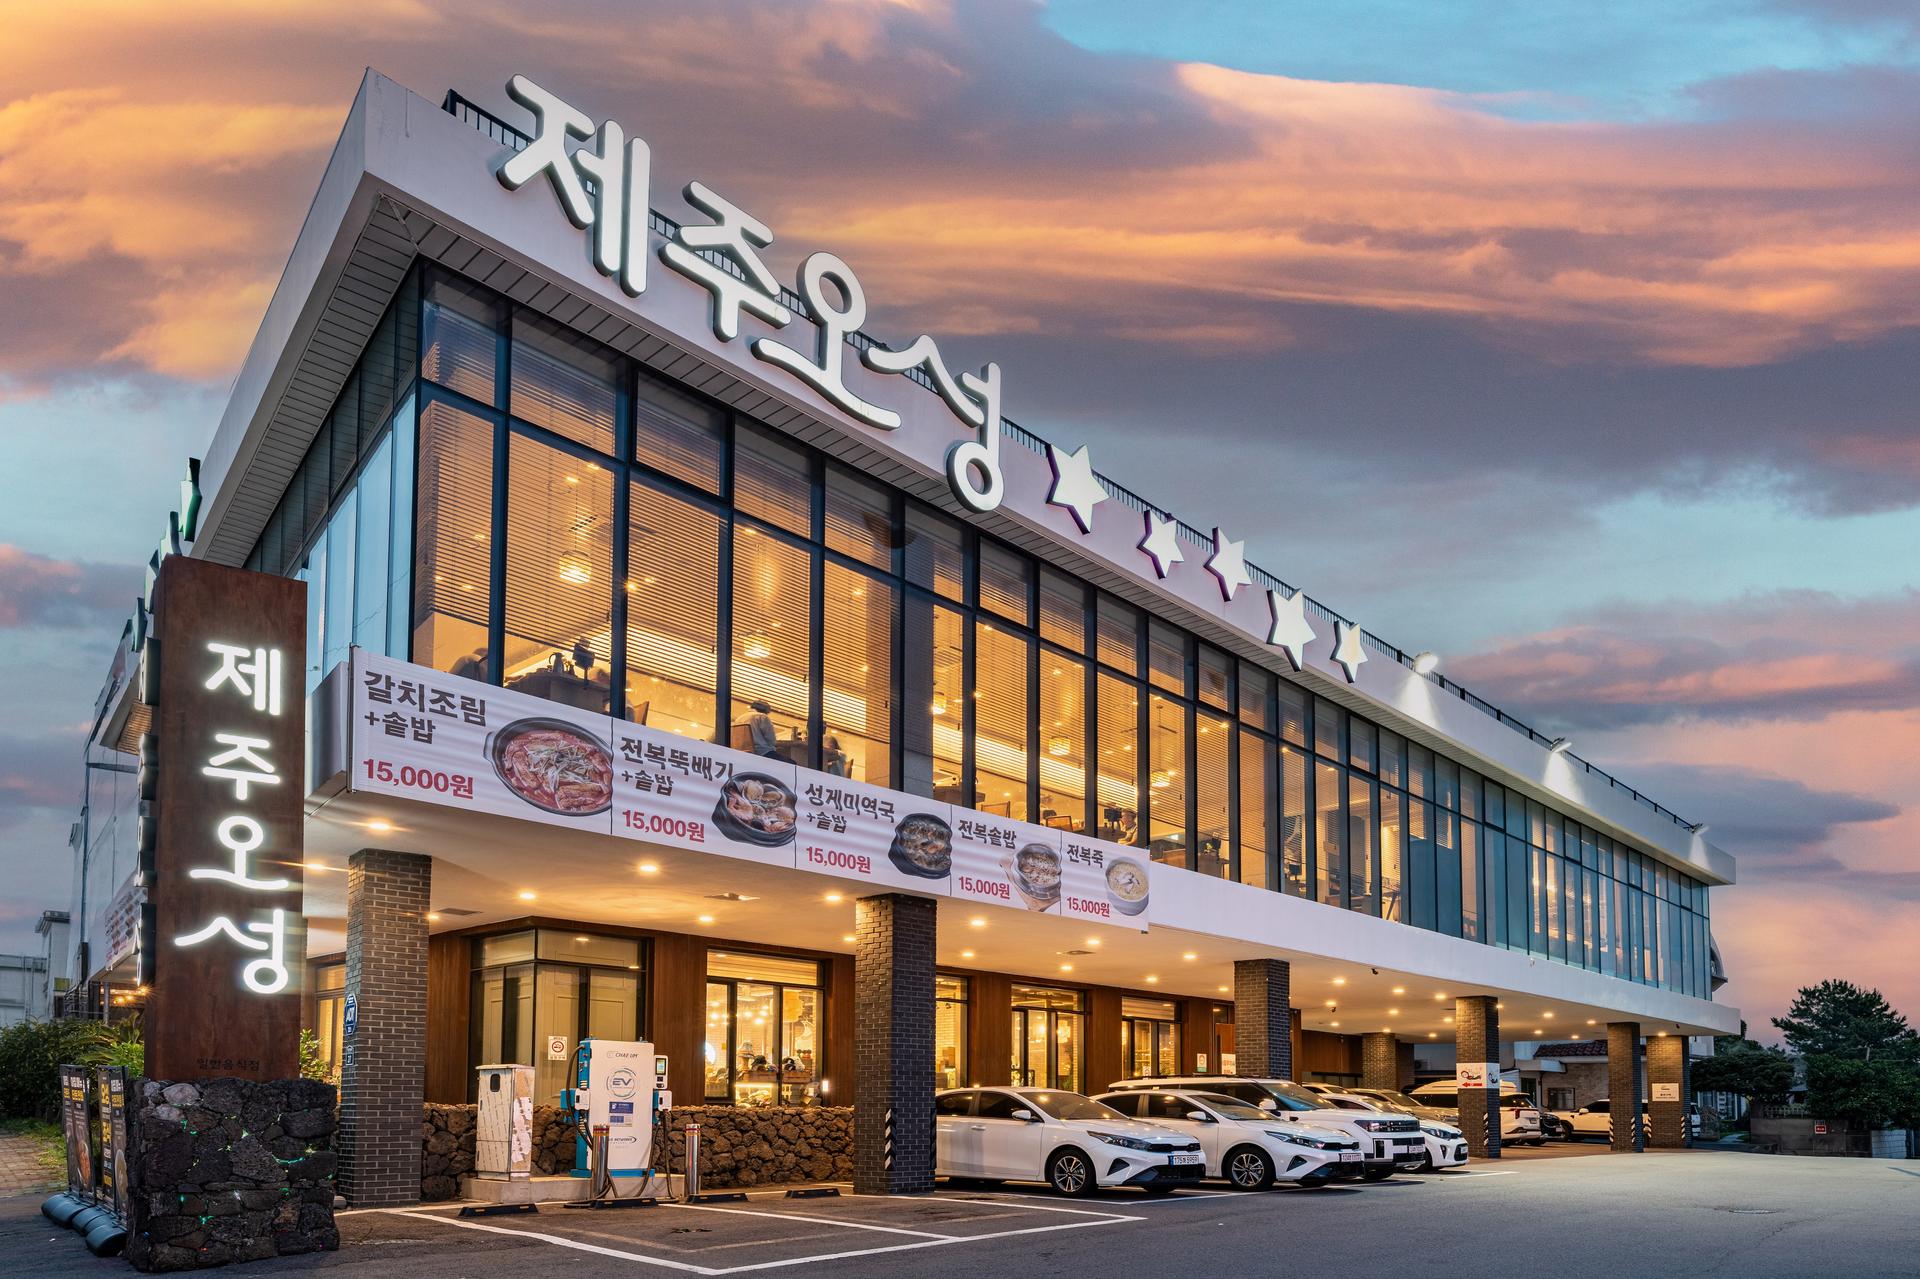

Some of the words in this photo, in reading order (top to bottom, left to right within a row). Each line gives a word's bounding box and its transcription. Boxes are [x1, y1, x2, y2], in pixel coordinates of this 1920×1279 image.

[496, 73, 1004, 513] 제주오성
[364, 670, 487, 727] 갈치조림
[364, 711, 436, 744] +솥밥
[620, 736, 733, 781] 전복뚝배기
[363, 758, 474, 799] 15,000원
[621, 769, 674, 796] +솥밥
[174, 642, 289, 994] 제주오성
[805, 783, 895, 823] 성게미역국
[622, 809, 705, 843] 15,000원
[958, 819, 1017, 850] 전복솥밥
[806, 846, 871, 874] 15,000원
[1066, 843, 1104, 869] 전복죽
[958, 875, 1011, 900] 15,000원
[1066, 896, 1110, 918] 15,000원
[612, 1077, 632, 1086] EV
